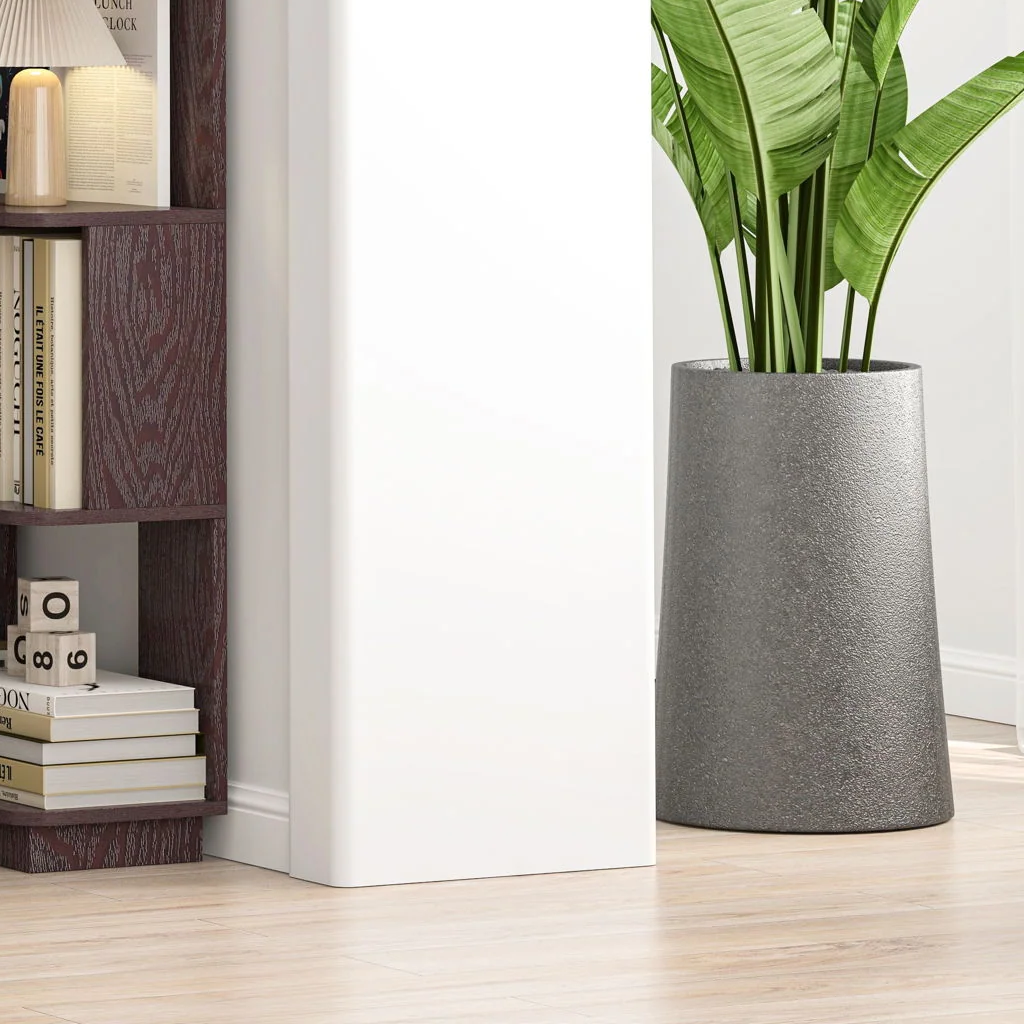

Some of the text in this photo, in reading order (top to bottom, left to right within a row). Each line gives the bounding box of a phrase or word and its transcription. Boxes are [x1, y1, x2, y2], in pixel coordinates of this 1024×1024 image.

[36, 306, 45, 457] IL ÉTAIT UNE FOIS LE CAFÉ
[32, 651, 53, 670] 8
